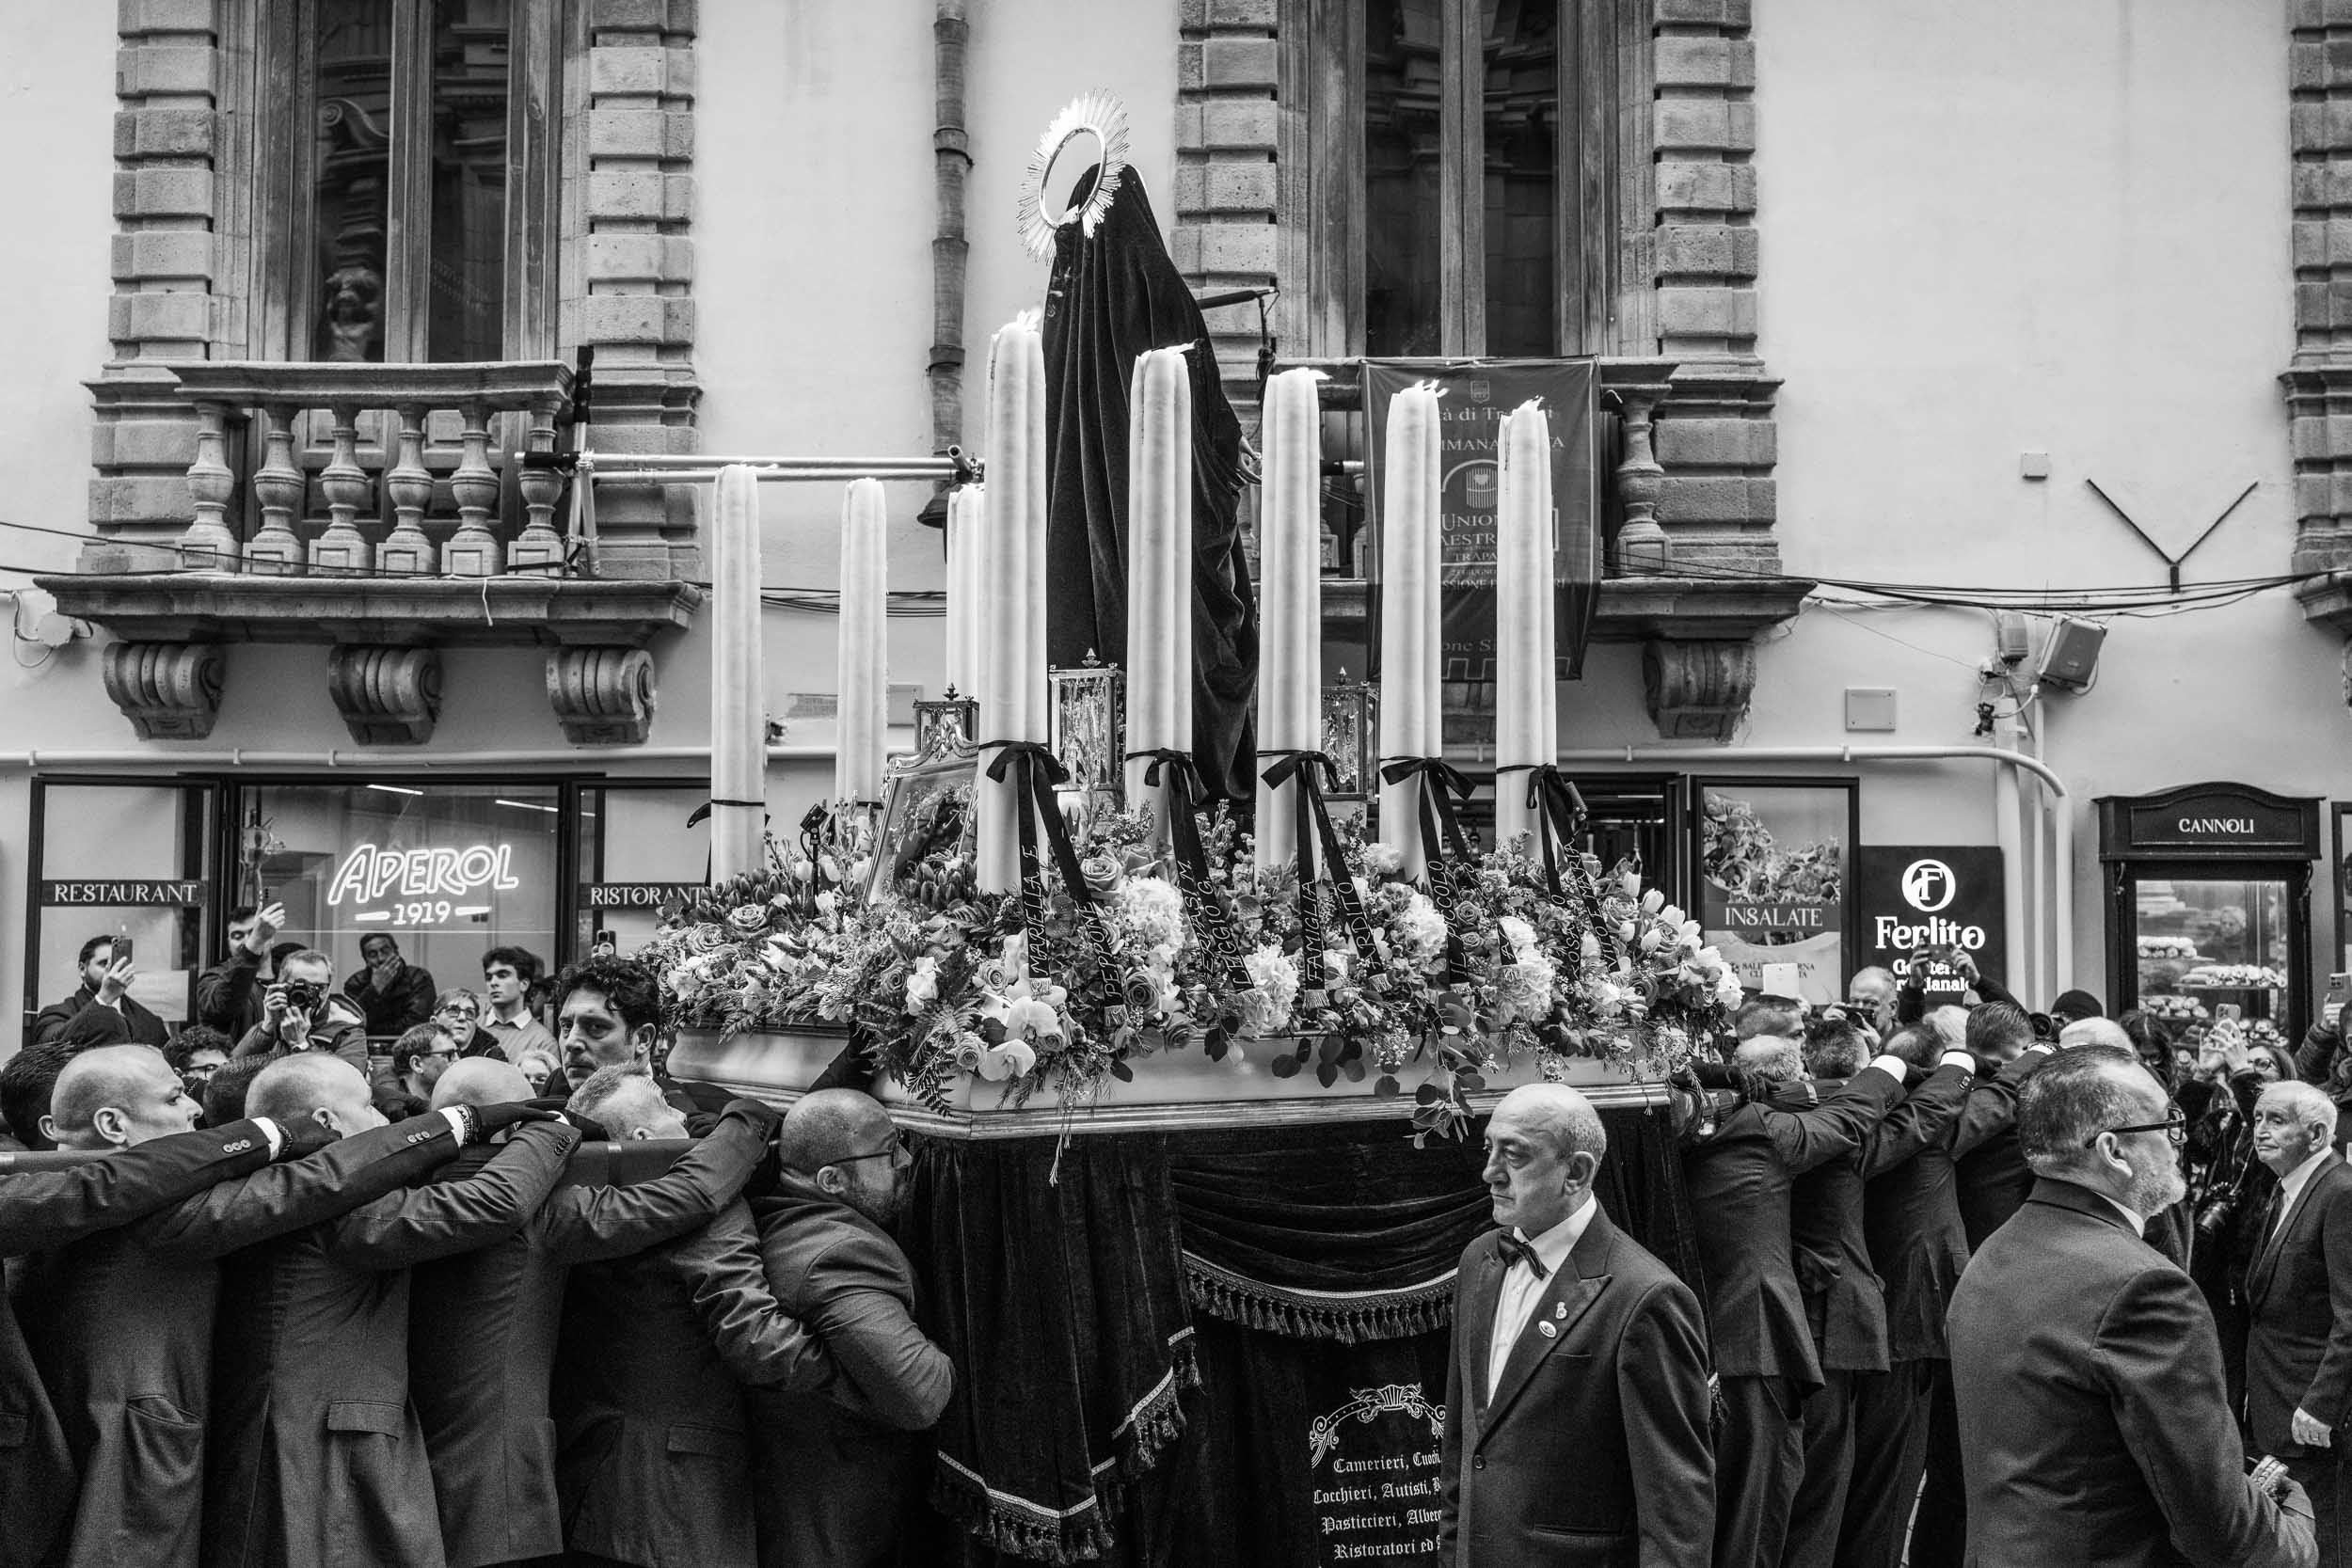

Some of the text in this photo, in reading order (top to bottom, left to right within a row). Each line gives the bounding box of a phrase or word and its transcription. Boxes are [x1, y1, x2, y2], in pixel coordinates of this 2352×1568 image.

[1458, 406, 1476, 421] di
[1441, 437, 1499, 451] IMANA
[1441, 513, 1498, 531] UNIO
[2178, 818, 2254, 833] CANNOLI
[327, 844, 519, 905] APEROL
[55, 884, 197, 902] RESTAURANT
[591, 887, 707, 905] RISTORANT
[392, 900, 452, 926] 1919
[1021, 845, 1049, 976] MARIELLA E
[1586, 906, 1603, 918] E
[1724, 907, 1823, 927] INSALATE
[1301, 878, 1324, 982] FAMIGLIA
[1336, 881, 1382, 970] ARDITO
[1874, 915, 1986, 950] Ferlito
[1074, 899, 1122, 998] PEPPONE
[1450, 952, 1468, 976] IL
[1333, 1454, 1409, 1473] Camerieri,
[1313, 1485, 1377, 1505] Cocchieri,
[1381, 1480, 1432, 1498] Autisti,
[1321, 1513, 1402, 1535] Pasticcieri,
[1334, 1538, 1415, 1560] Ristoratori
[1420, 1538, 1434, 1553] ed
